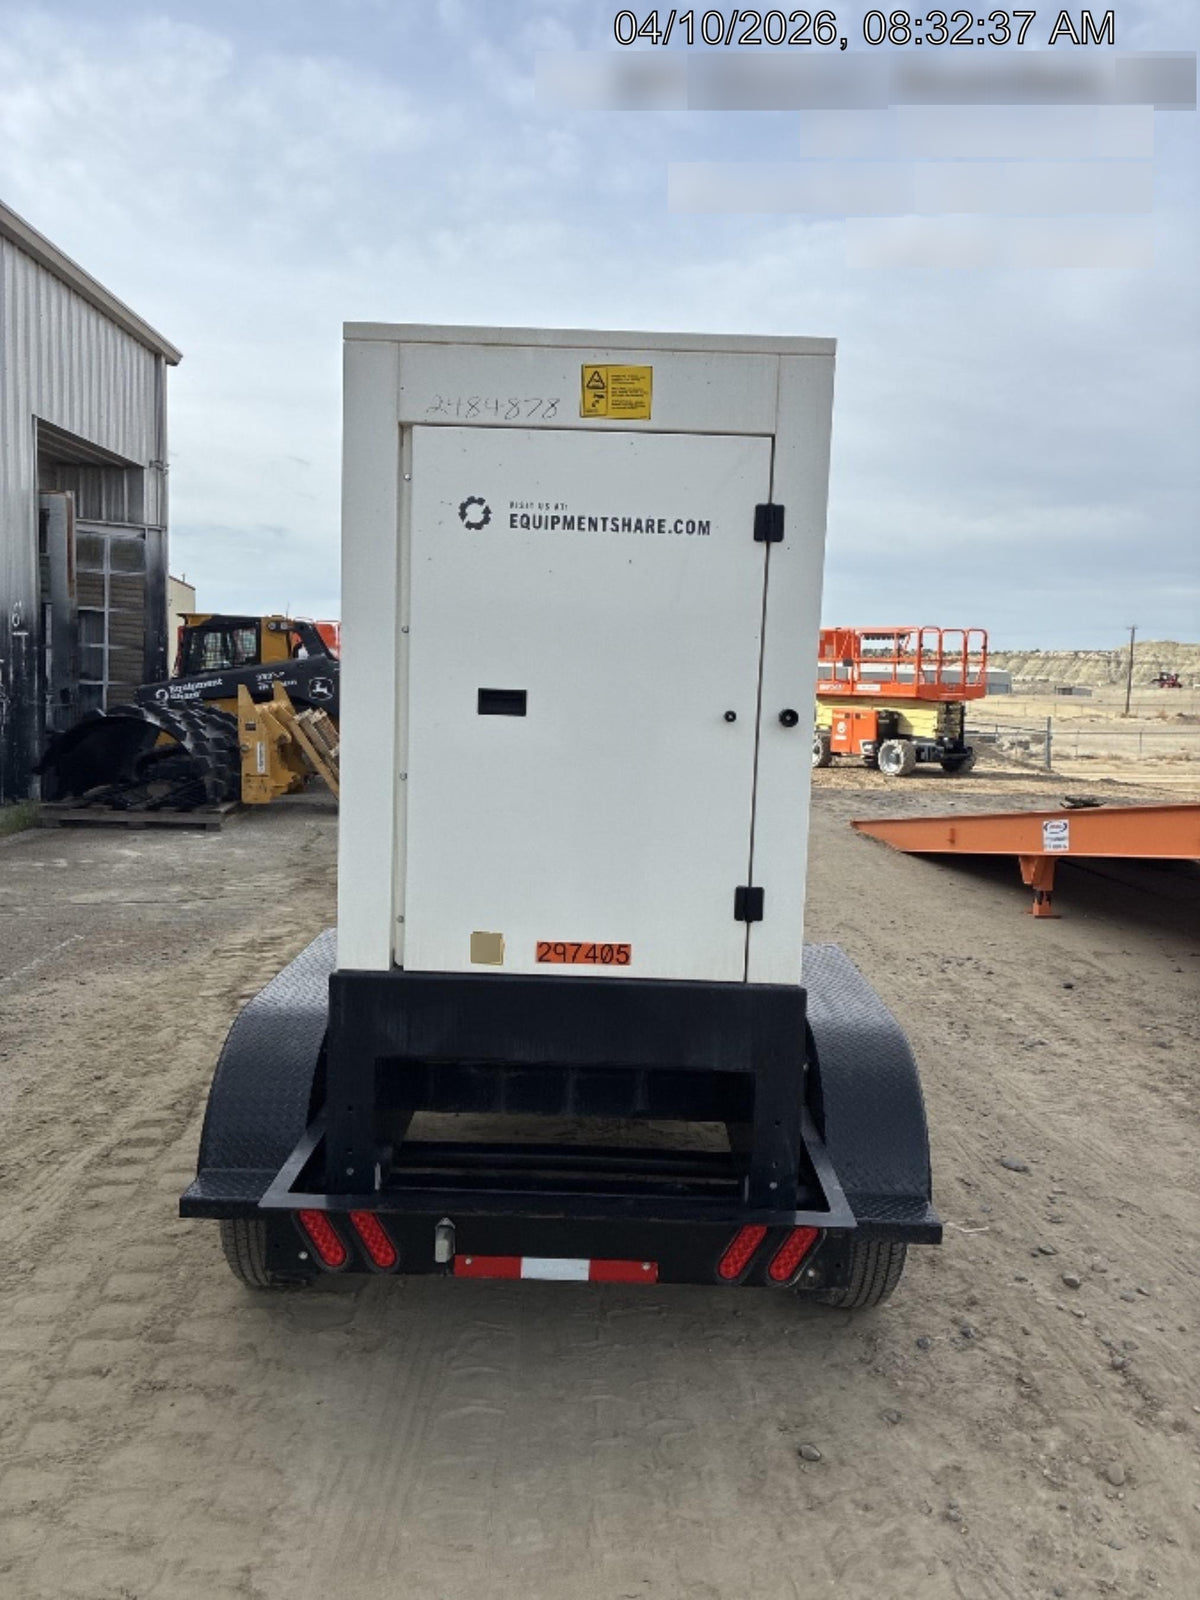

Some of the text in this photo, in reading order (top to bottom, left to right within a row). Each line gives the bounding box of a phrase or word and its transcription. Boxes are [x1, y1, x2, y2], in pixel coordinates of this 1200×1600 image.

[425, 394, 561, 420] 2484878
[538, 502, 551, 511] US
[509, 513, 710, 536] EQUIPMENTSHARE.COM
[538, 942, 630, 965] 297405
